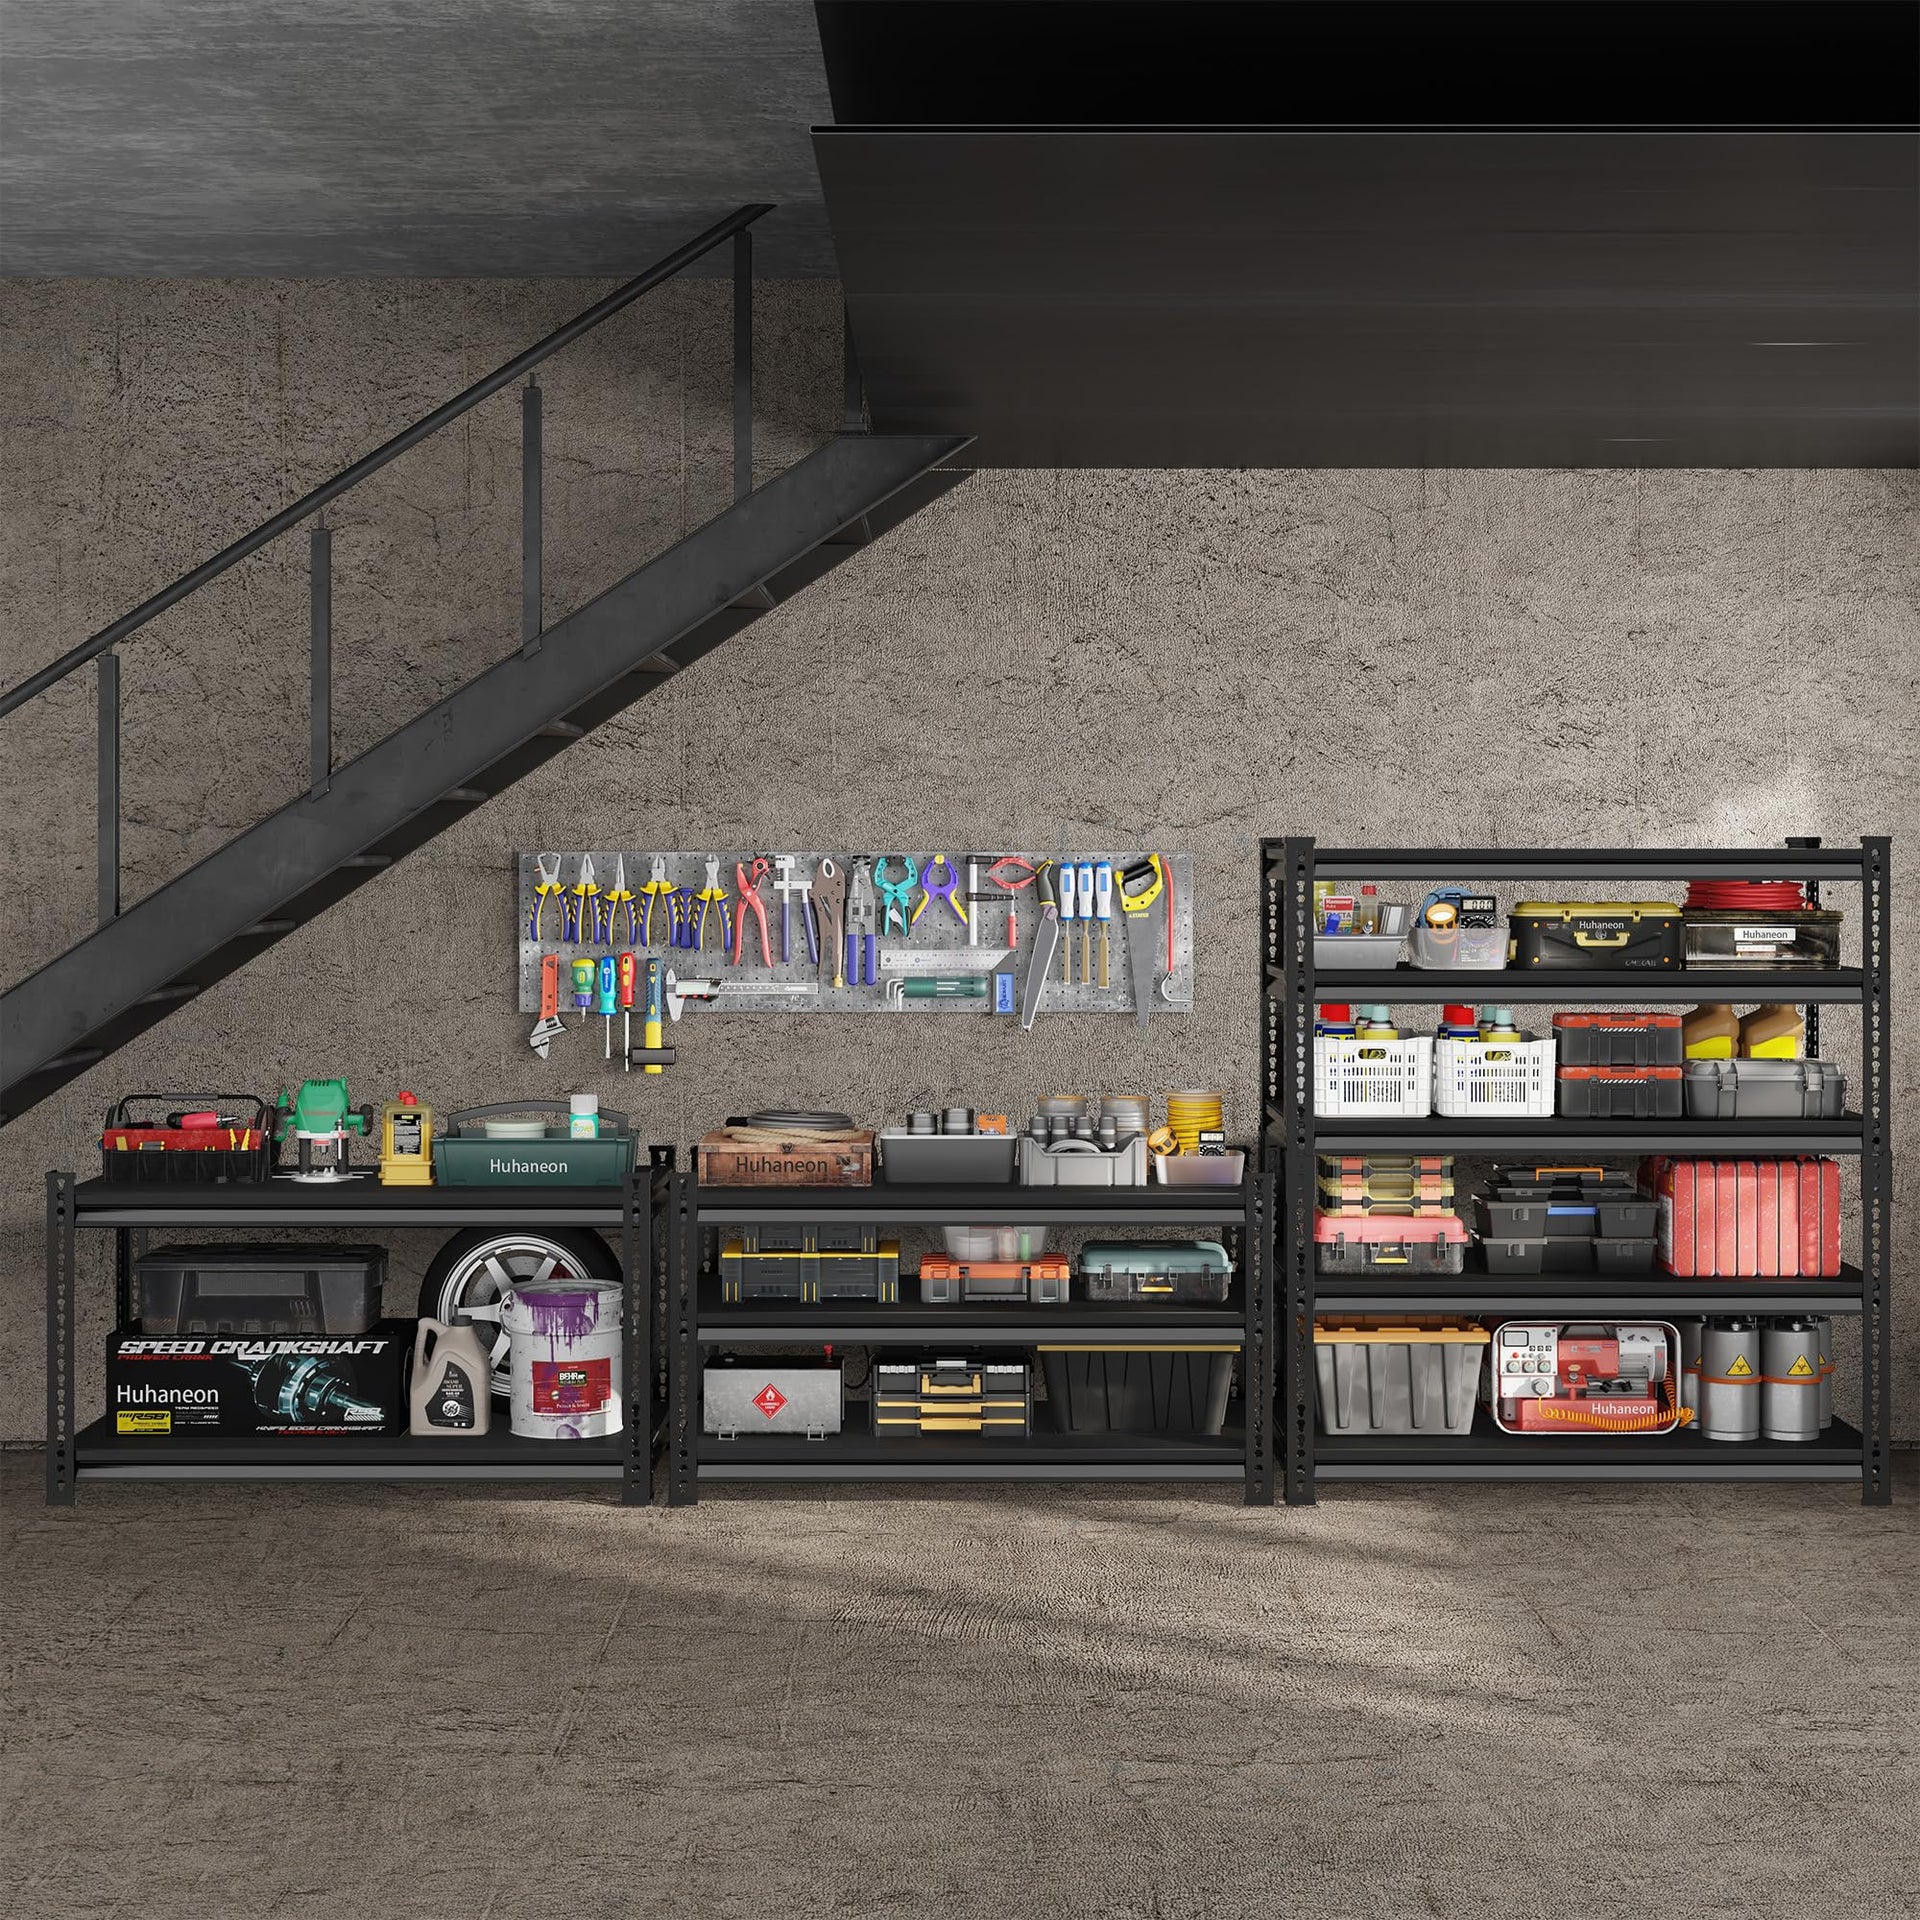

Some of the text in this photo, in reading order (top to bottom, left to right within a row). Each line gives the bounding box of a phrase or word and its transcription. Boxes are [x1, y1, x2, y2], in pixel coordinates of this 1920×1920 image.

[1579, 920, 1625, 930] Huhaneon
[1743, 930, 1788, 939] Huhaneon
[490, 1158, 568, 1173] Huhaneon
[736, 1156, 828, 1173] Huhaneon
[117, 1341, 389, 1360] SPEED CRANKSHAFT
[117, 1383, 220, 1403] Huhaneon
[1591, 1403, 1655, 1415] Huhaneon
